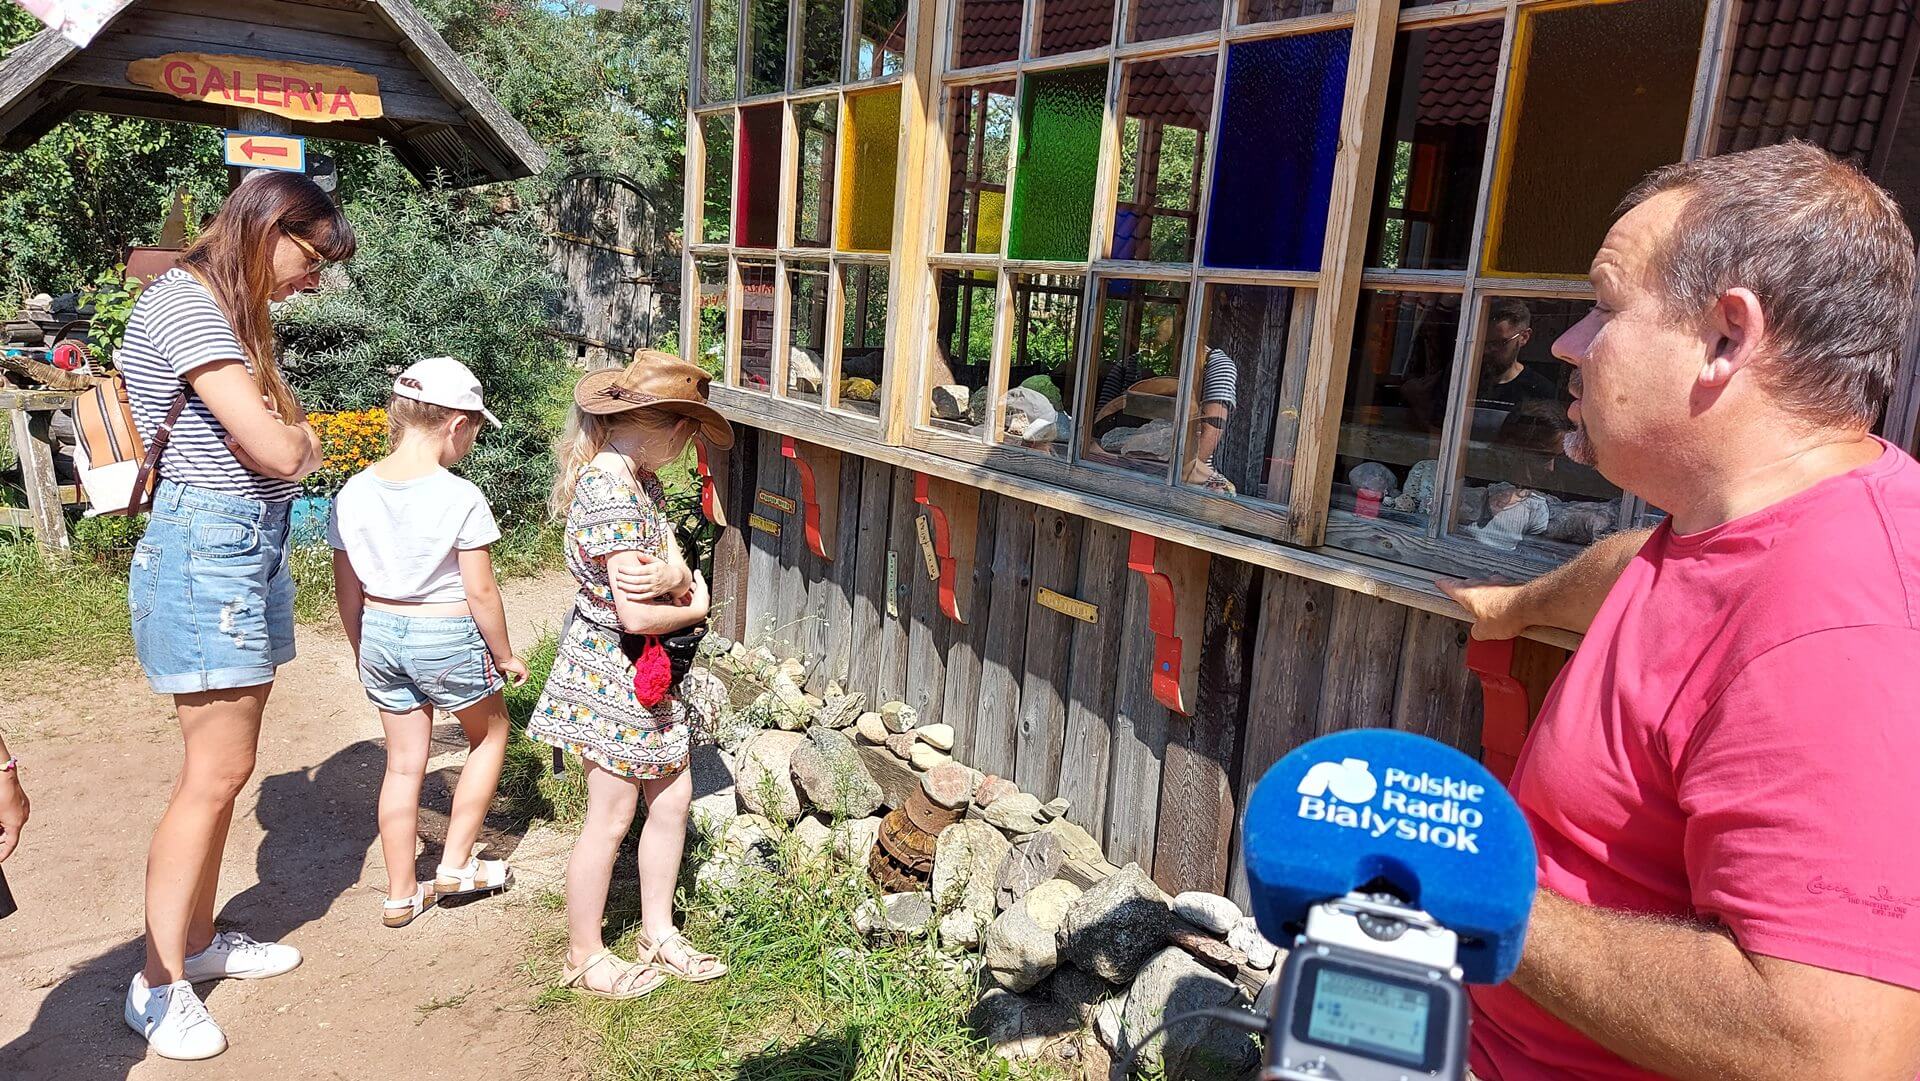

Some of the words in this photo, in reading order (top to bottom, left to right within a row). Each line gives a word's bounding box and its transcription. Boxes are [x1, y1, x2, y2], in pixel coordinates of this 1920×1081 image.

[163, 60, 358, 117] GALERIA
[1385, 767, 1485, 803] Polskie
[1297, 796, 1480, 854] Białystok
[1382, 790, 1484, 829] Radio
